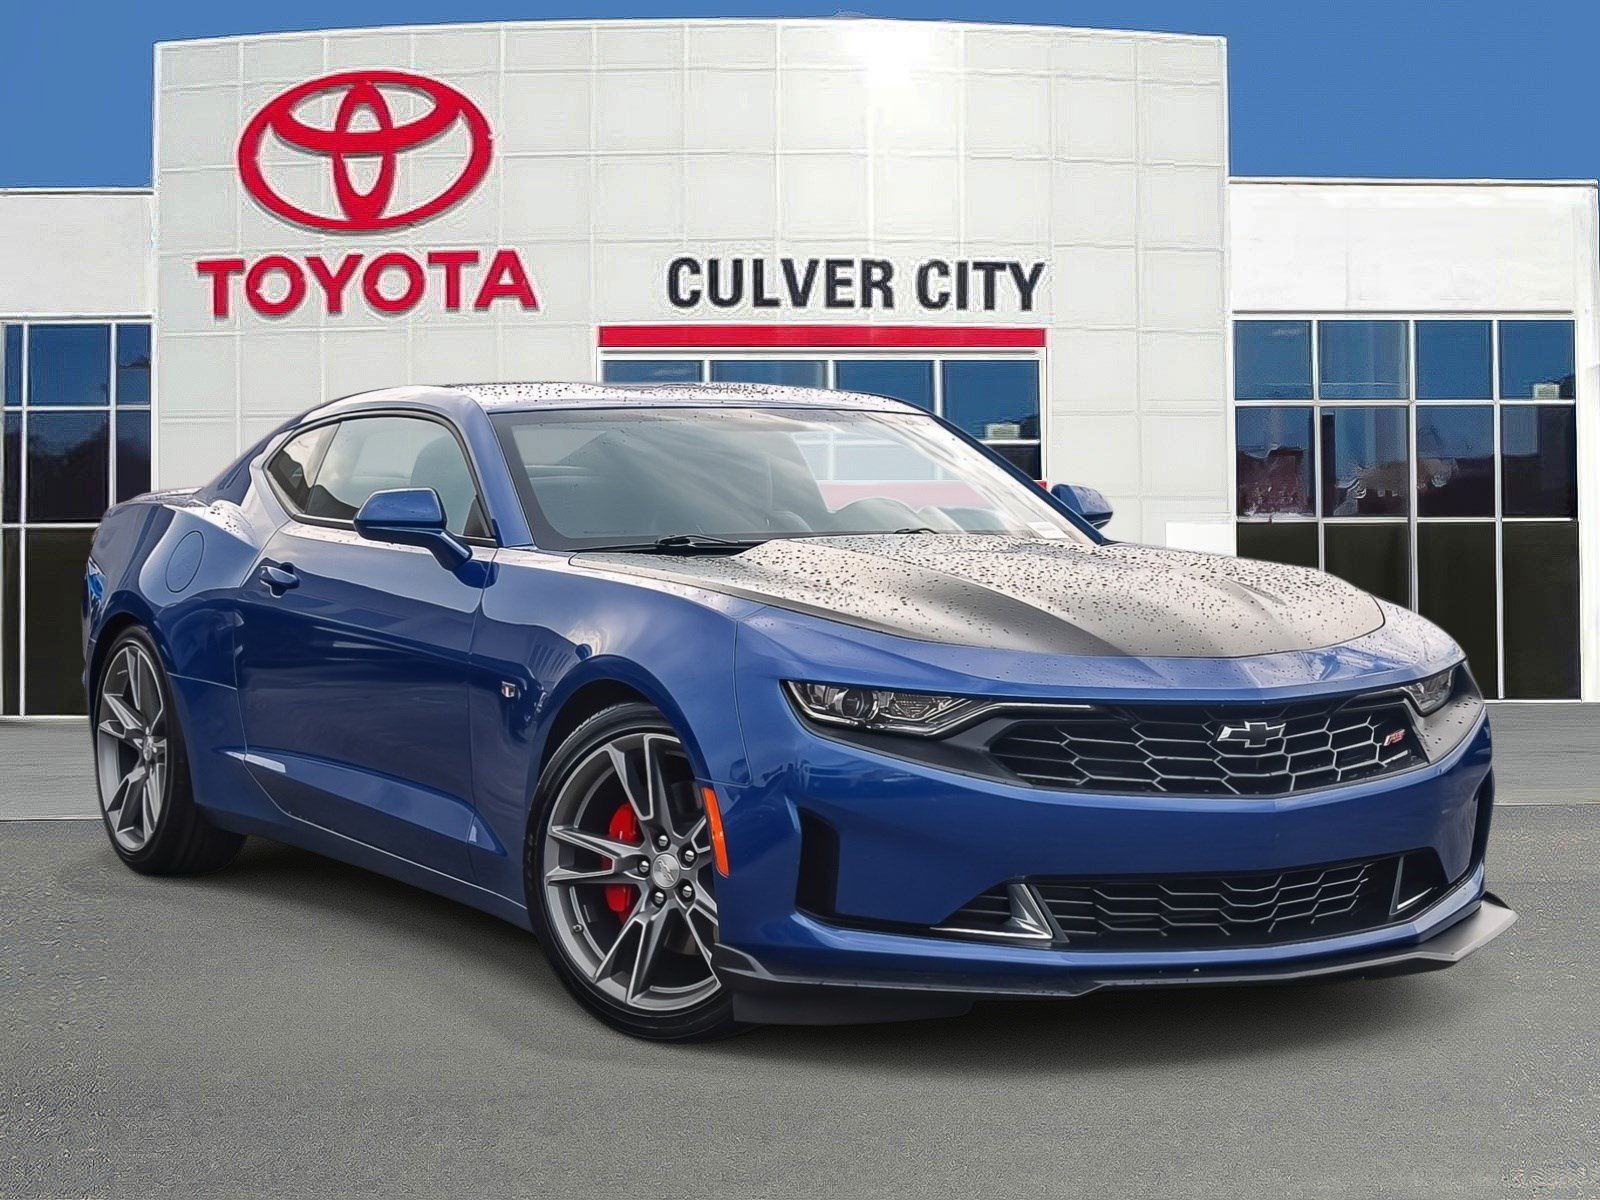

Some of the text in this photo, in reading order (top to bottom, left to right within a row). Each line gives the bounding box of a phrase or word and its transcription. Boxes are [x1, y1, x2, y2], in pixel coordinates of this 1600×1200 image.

[197, 249, 538, 319] TOYOTA
[668, 257, 1046, 312] CULVER CITY
